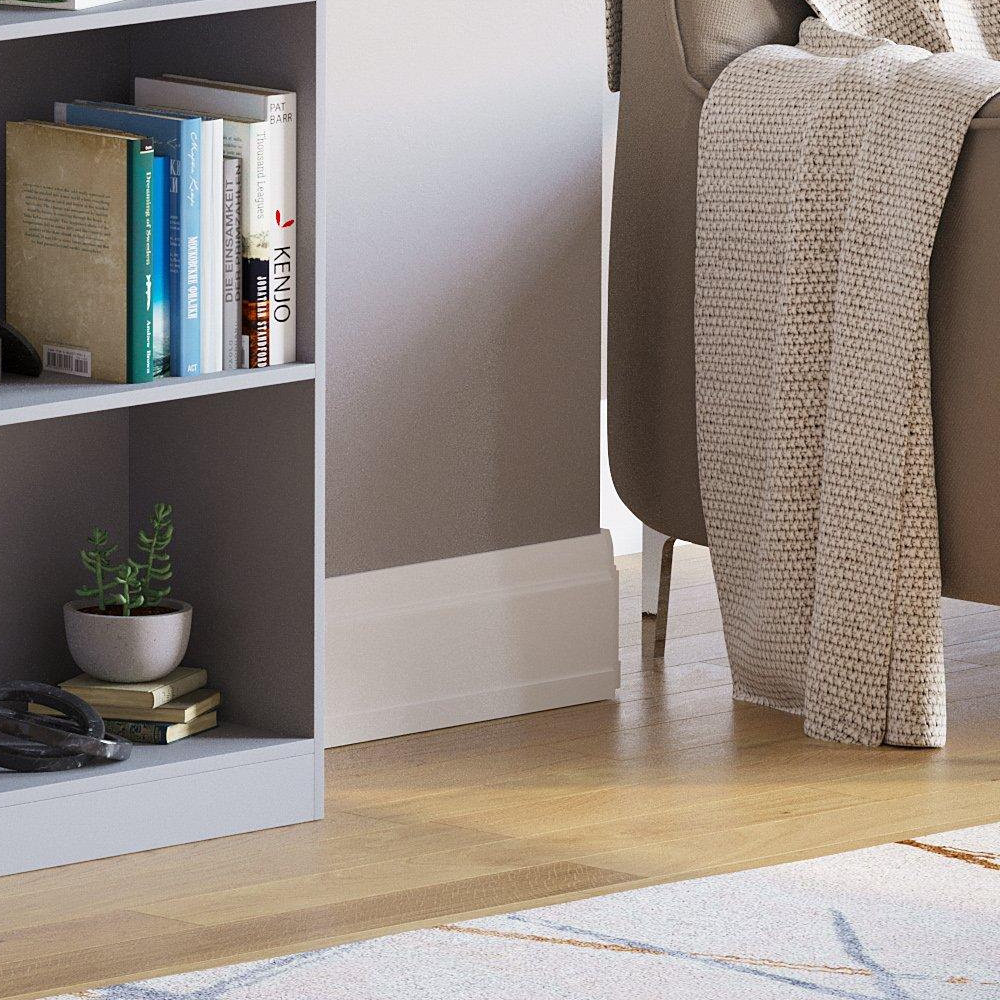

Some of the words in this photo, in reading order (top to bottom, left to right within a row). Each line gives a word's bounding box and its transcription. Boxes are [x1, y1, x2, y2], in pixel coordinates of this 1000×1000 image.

[270, 102, 286, 112] PAT
[270, 113, 292, 124] BARR
[256, 131, 266, 179] Thousand
[254, 180, 266, 220] Leagues
[146, 218, 152, 228] of
[226, 180, 234, 269] EINSAMKEIT
[226, 282, 234, 303] DIE
[257, 276, 267, 318] JONATHAN
[274, 246, 290, 322] KENJO
